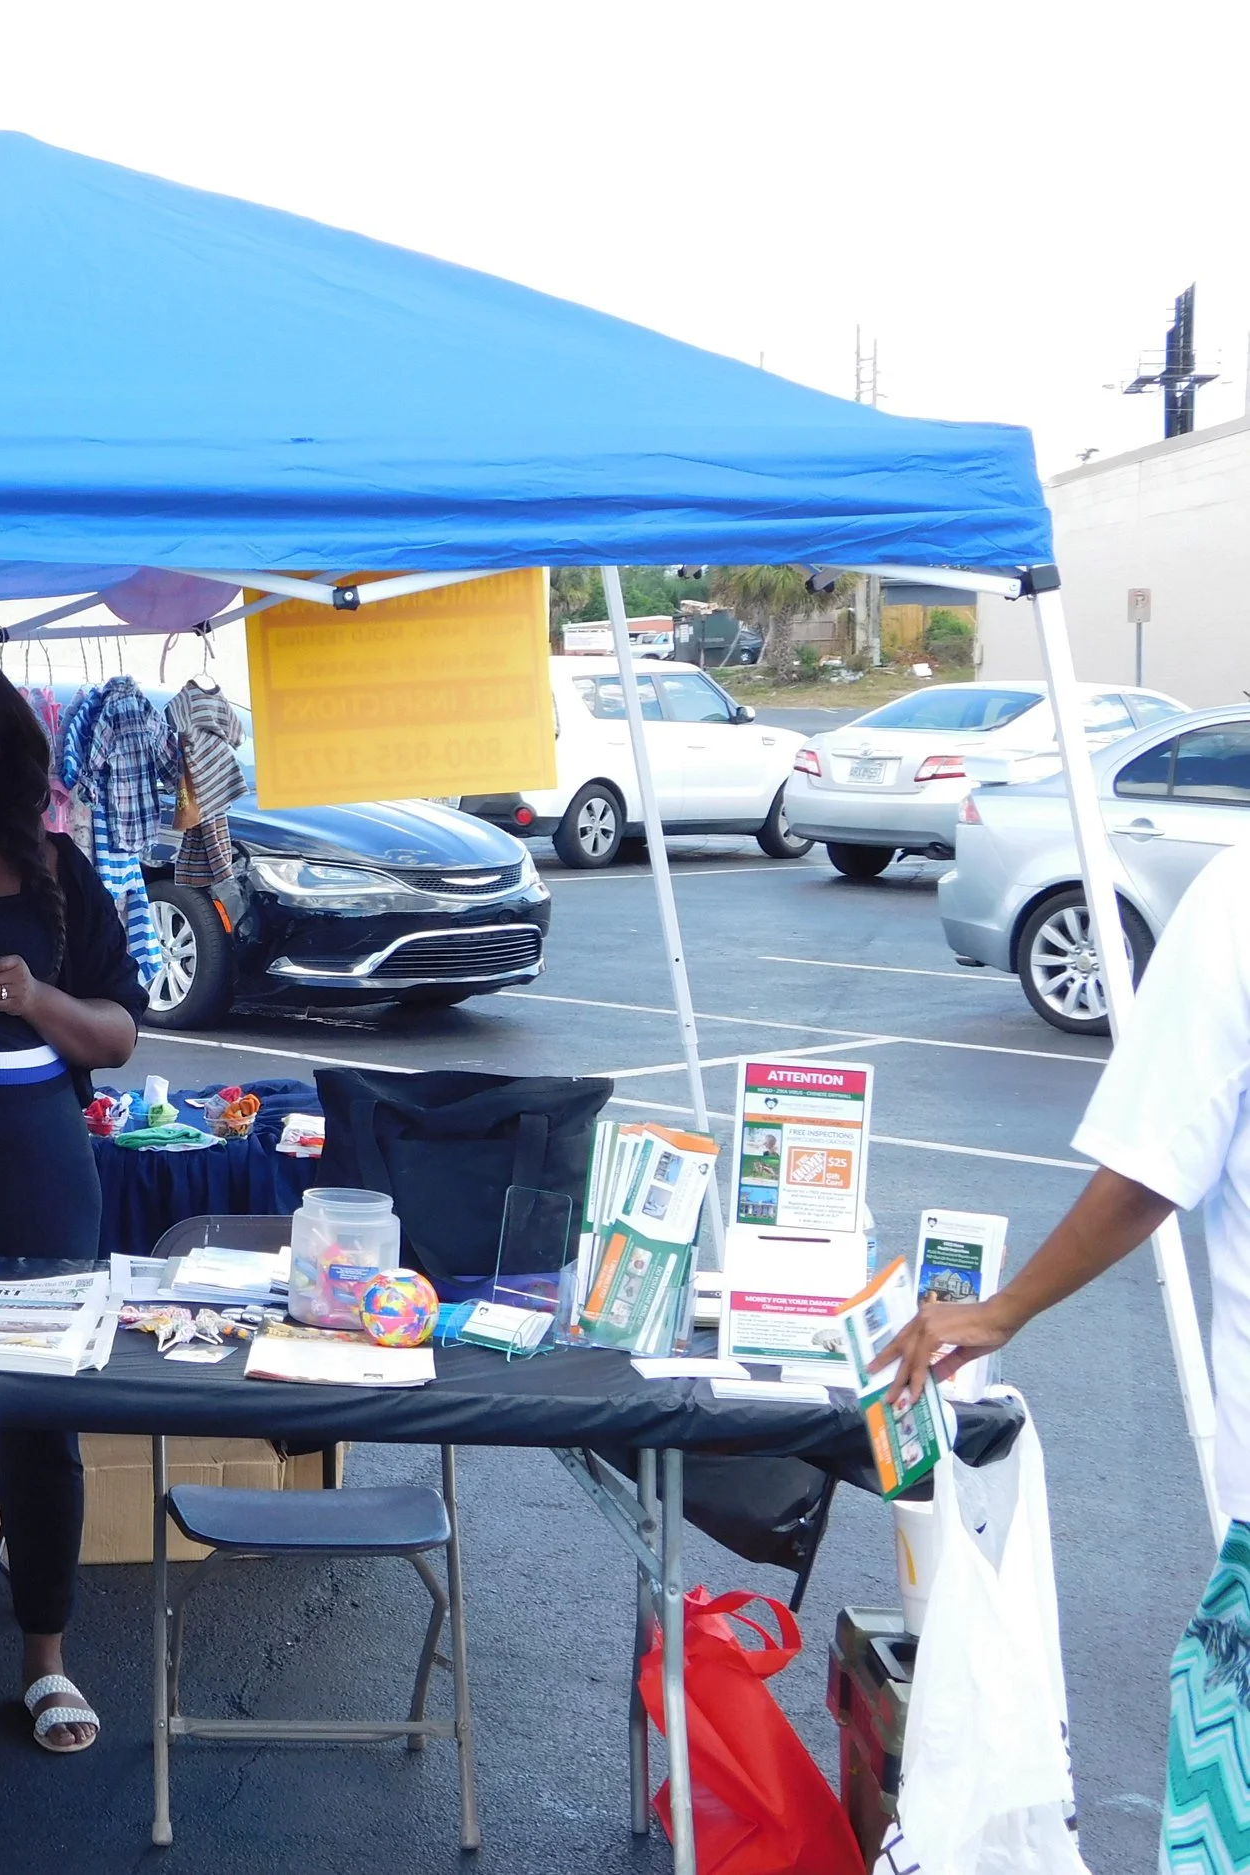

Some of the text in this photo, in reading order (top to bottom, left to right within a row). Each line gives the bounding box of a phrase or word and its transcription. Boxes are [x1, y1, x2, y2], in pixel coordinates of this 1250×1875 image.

[768, 1070, 844, 1086] ATTENTION
[789, 1128, 854, 1140] FREE INSPECTIONS
[828, 1157, 847, 1168] $25
[744, 1295, 772, 1303] MONEY
